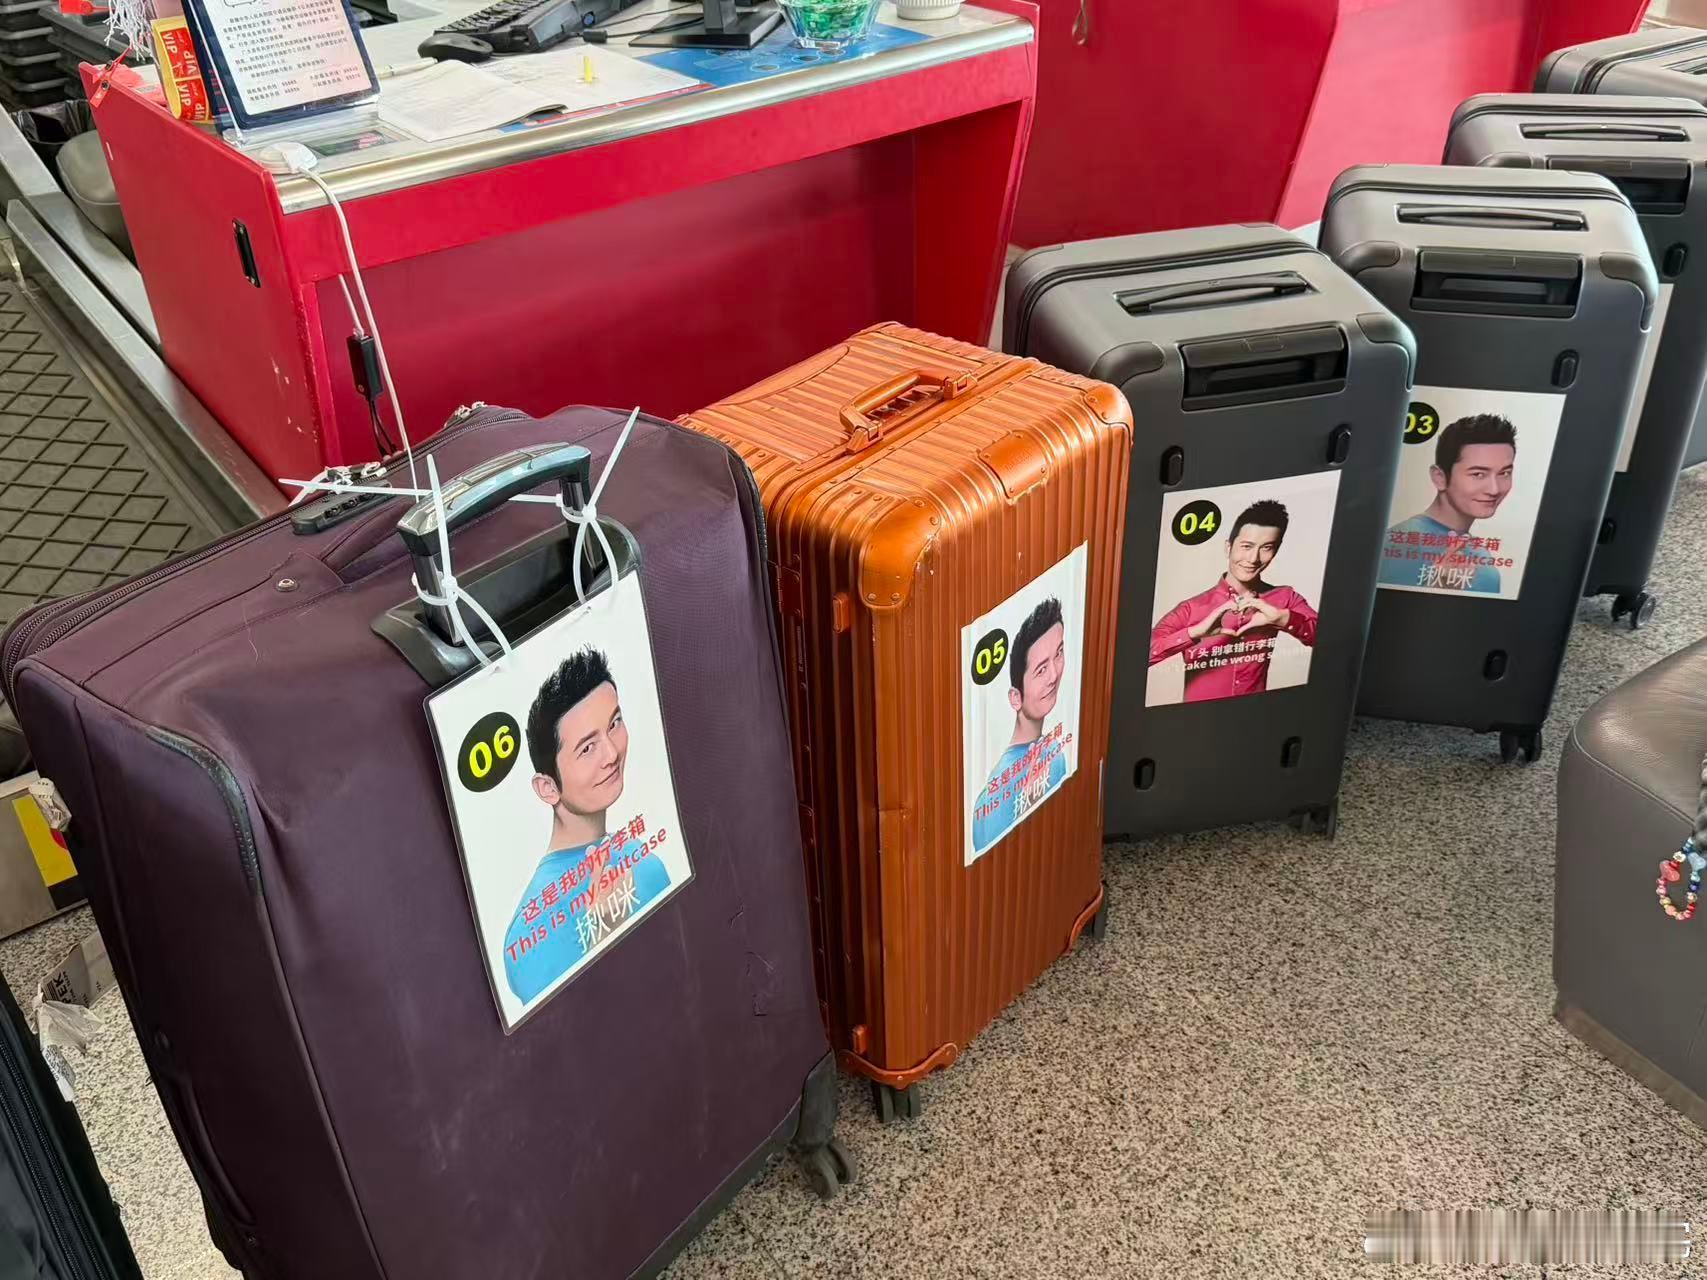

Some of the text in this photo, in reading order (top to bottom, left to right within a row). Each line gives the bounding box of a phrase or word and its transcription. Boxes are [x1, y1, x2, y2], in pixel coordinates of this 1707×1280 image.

[163, 32, 178, 54] VIP
[183, 50, 197, 75] VIP
[179, 83, 192, 106] VIP
[1180, 511, 1216, 535] 04
[1390, 530, 1501, 551] 这是我的行李箱
[1407, 548, 1418, 560] is
[1422, 551, 1445, 565] my
[1448, 552, 1513, 567] suitcase
[1417, 564, 1474, 589] 揪咪
[975, 638, 1005, 675] 05
[1183, 659, 1207, 670] take
[1209, 656, 1228, 667] the
[1230, 652, 1265, 664] wrong
[1188, 647, 1209, 659] 丫头
[469, 725, 515, 779] 06
[988, 722, 1063, 795] 这是我的行李箱
[976, 733, 1073, 820] This is my suitcase
[1013, 771, 1050, 820] 揪咪
[522, 813, 646, 924] 这是我的行李箱
[506, 827, 667, 963] This is my suitcase
[576, 879, 641, 953] 揪咪
